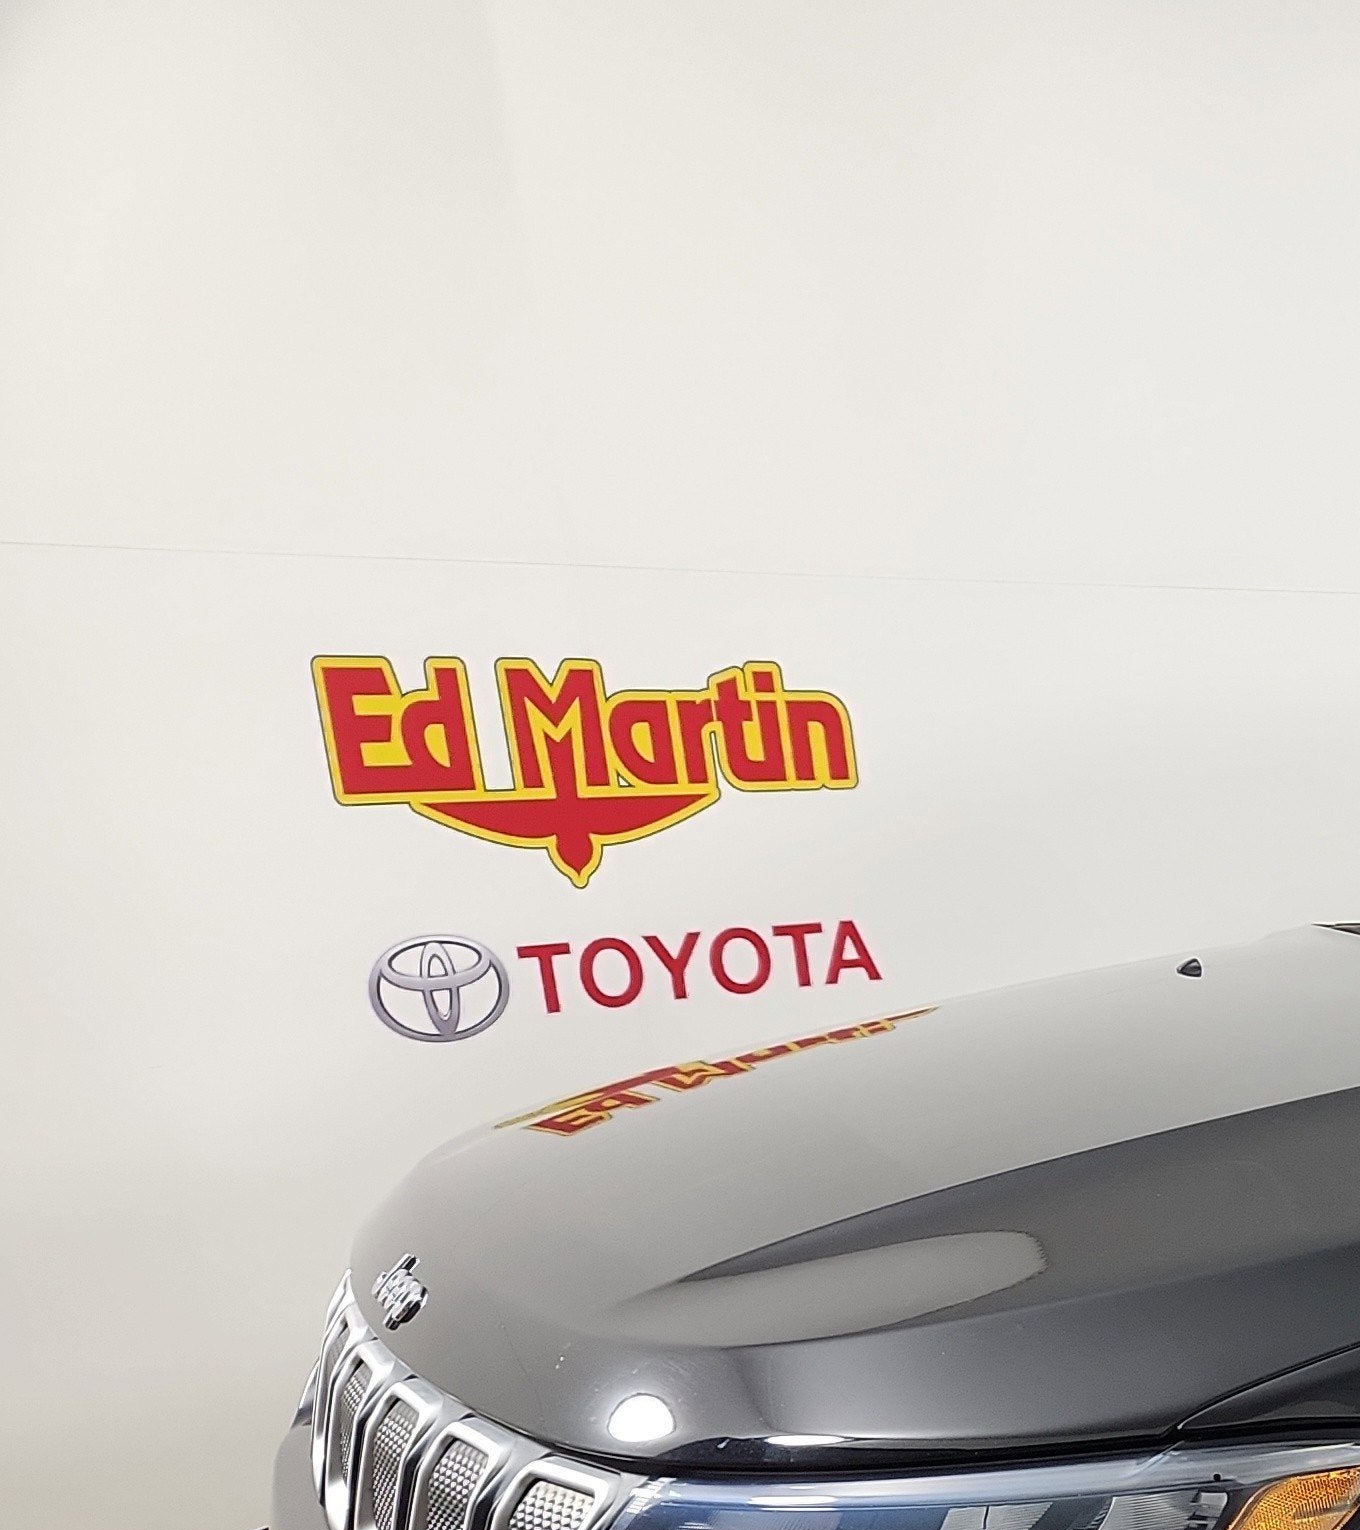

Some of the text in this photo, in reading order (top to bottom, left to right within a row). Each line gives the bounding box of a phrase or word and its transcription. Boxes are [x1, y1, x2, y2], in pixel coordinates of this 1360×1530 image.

[319, 665, 852, 797] Ed Martin
[516, 919, 882, 1014] TOYOTA
